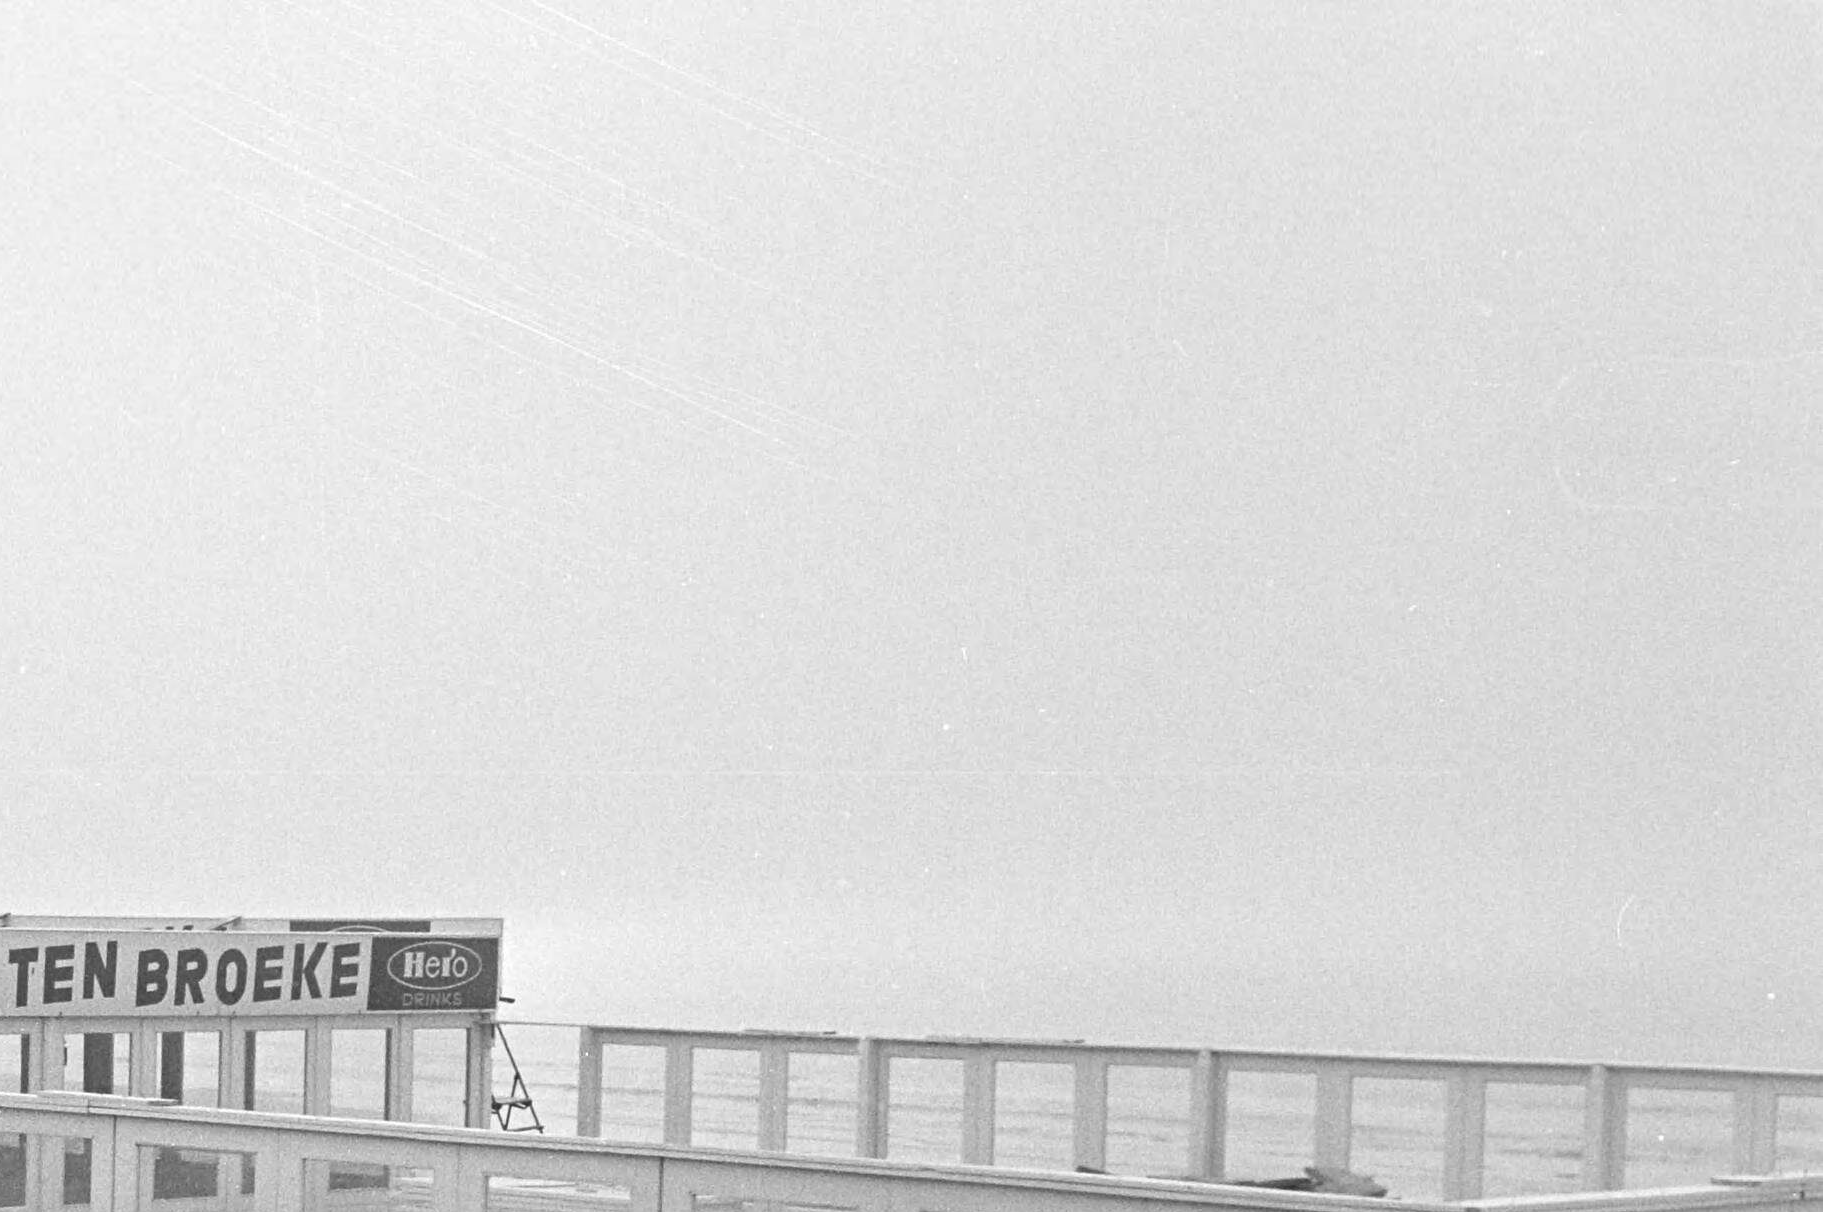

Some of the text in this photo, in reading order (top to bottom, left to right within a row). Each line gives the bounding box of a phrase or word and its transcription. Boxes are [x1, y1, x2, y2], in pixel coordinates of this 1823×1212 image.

[8, 940, 119, 1008] TEN
[135, 942, 362, 1007] BROEKE
[403, 947, 469, 980] Hero
[402, 992, 463, 1008] DRINKS
